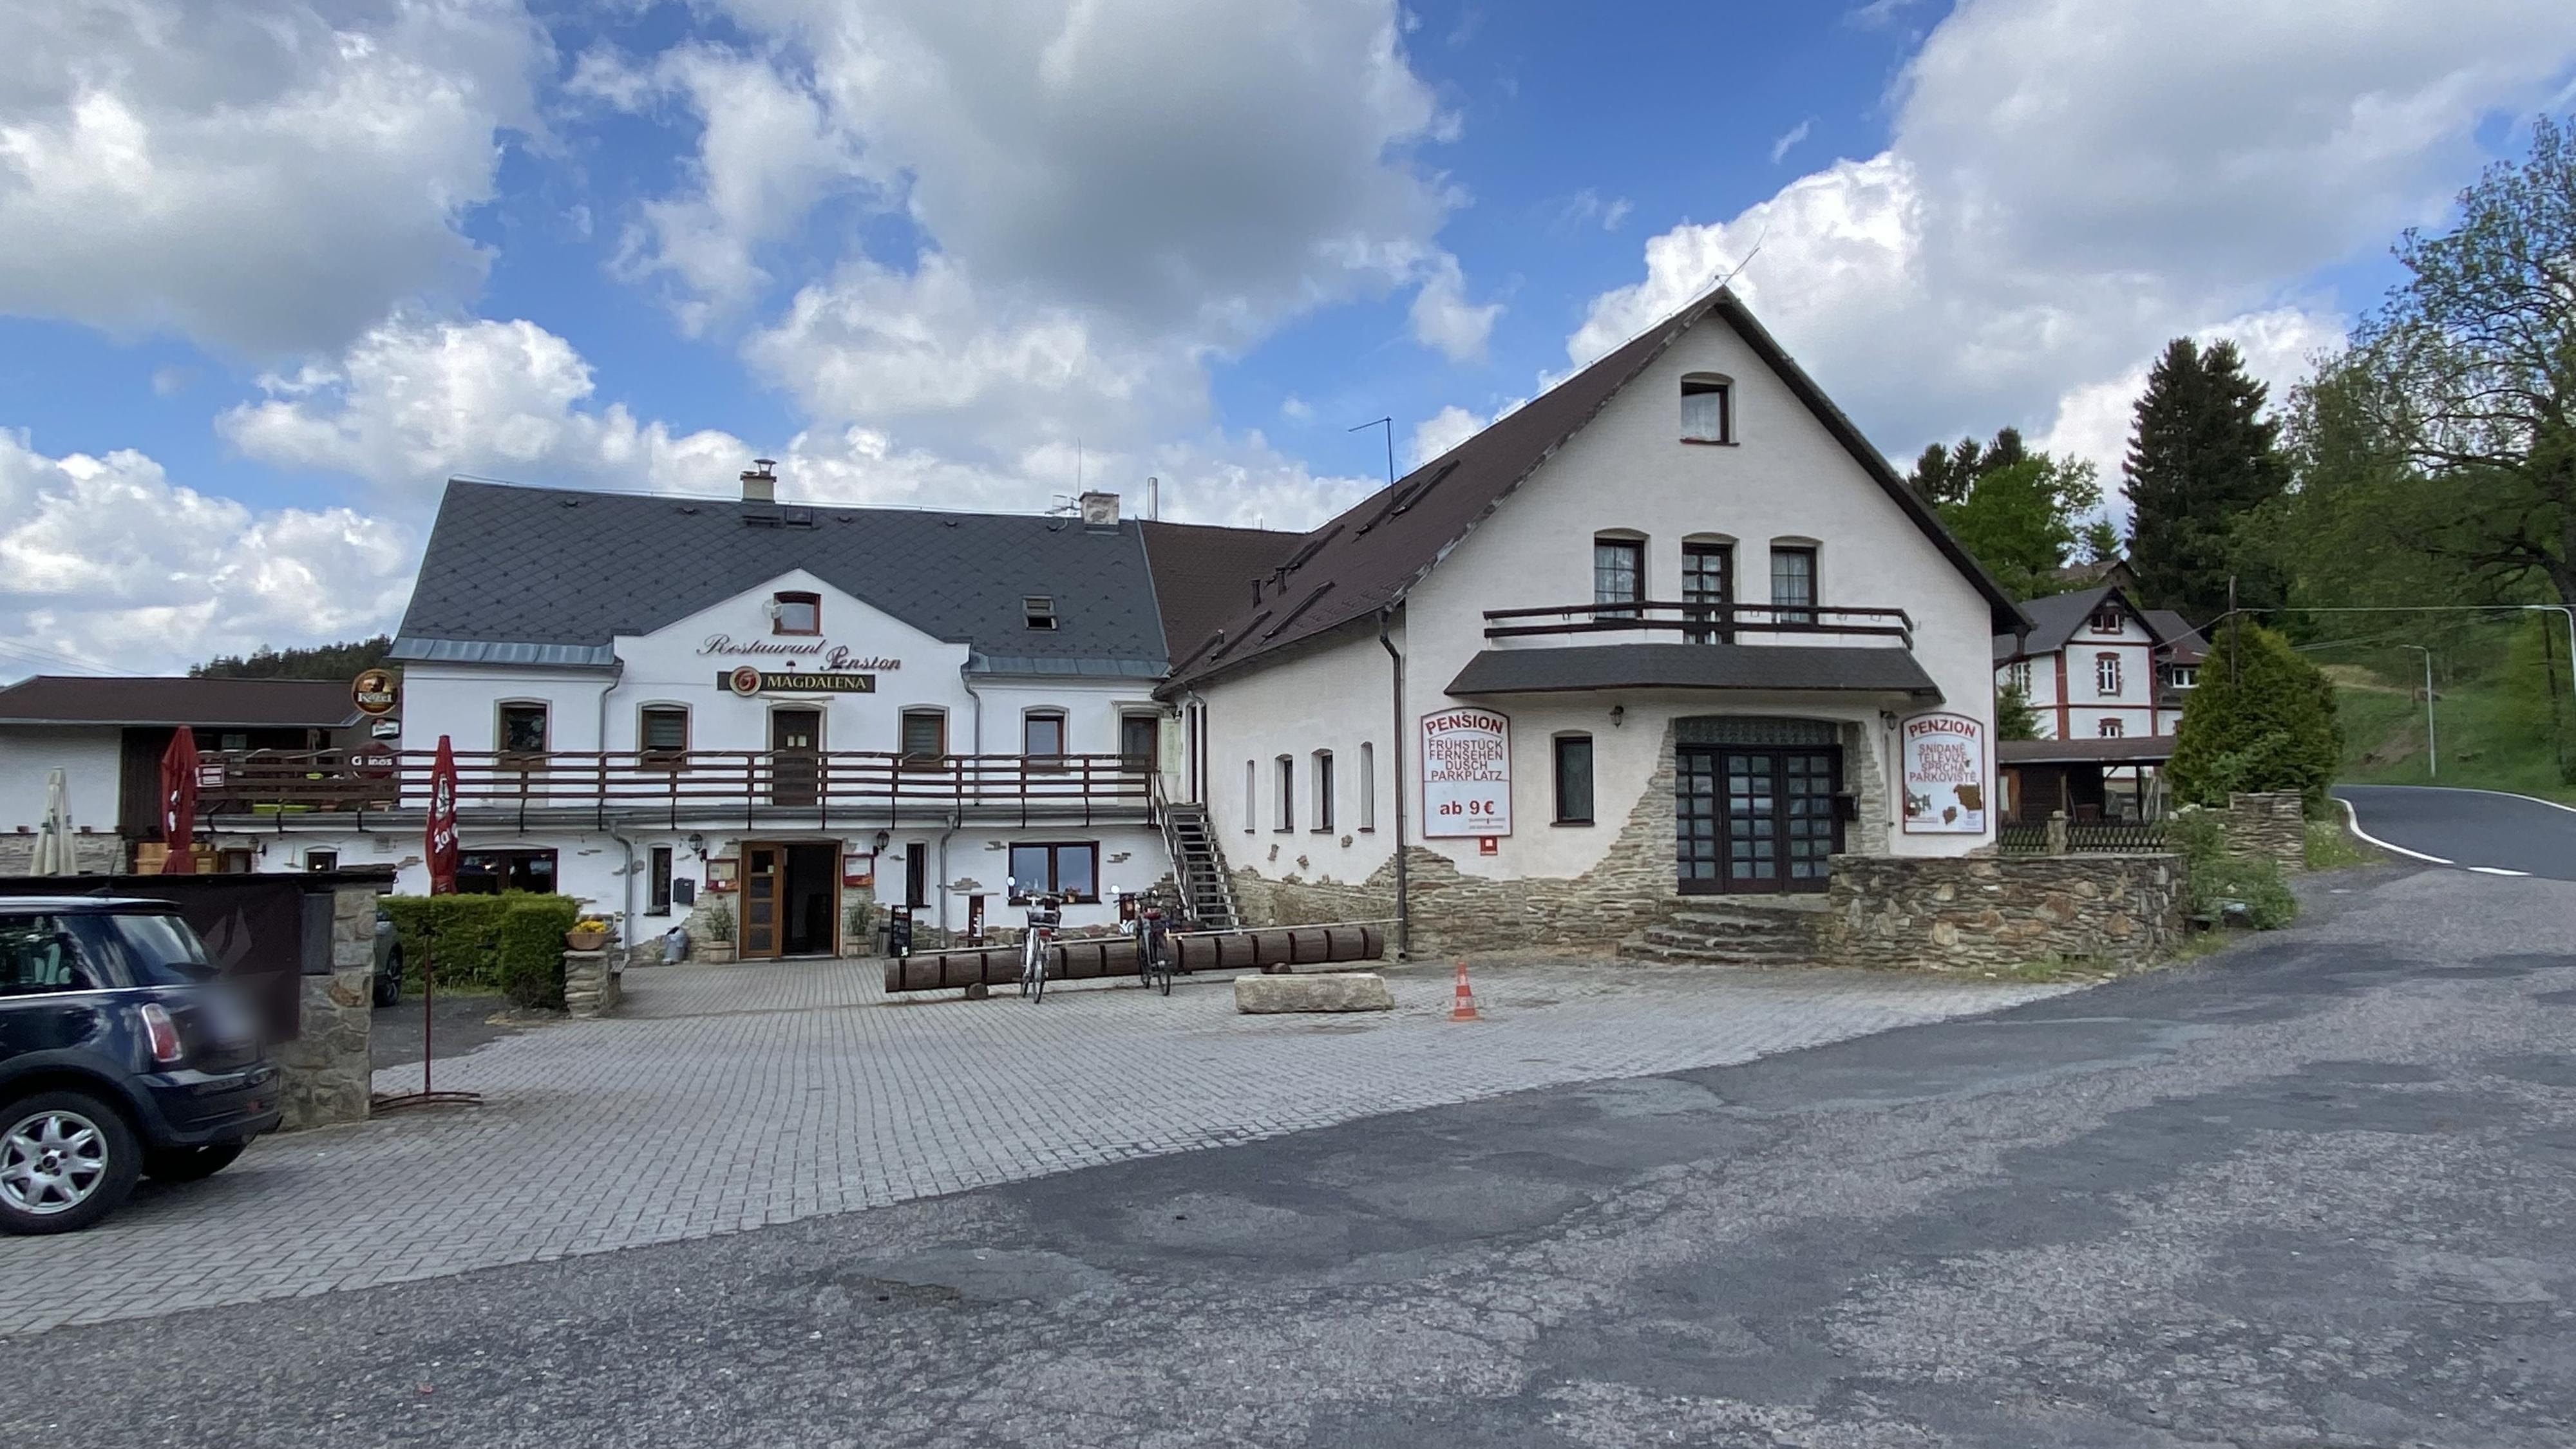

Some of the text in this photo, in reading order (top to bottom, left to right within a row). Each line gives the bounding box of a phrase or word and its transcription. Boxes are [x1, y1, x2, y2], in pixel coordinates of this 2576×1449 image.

[696, 634, 827, 656] Restaurant
[819, 645, 902, 672] Pension
[767, 675, 866, 690] MAGDALENA
[1909, 719, 1976, 738] PENZION
[1429, 750, 1503, 761] FERNSEHEN
[1445, 761, 1488, 770] DUSCH
[1921, 762, 1964, 773] SPRCHA
[1431, 770, 1502, 781] PARKPLATZ
[1440, 800, 1463, 816] ab
